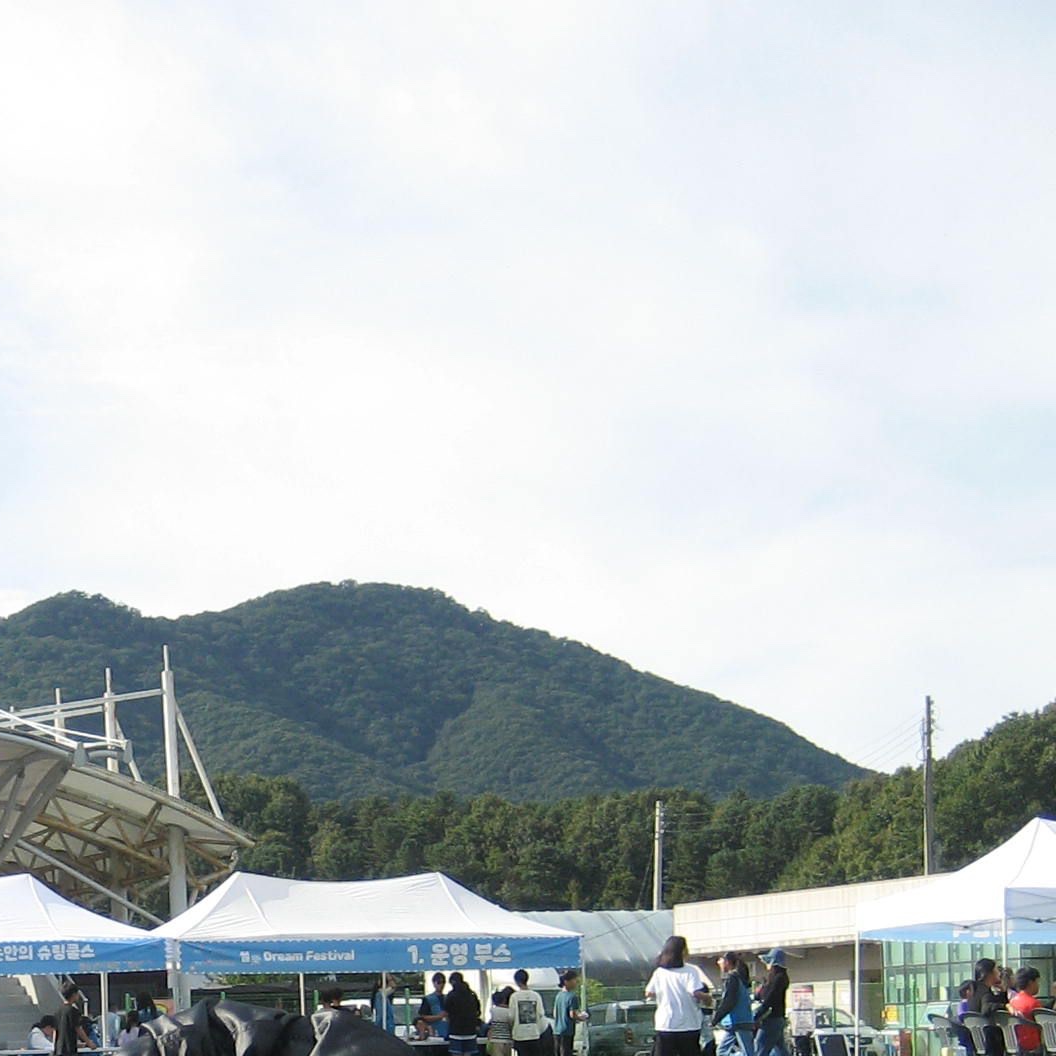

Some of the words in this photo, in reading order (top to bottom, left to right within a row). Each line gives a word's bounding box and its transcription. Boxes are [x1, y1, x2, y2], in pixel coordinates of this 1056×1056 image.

[263, 951, 303, 962] Dream
[305, 950, 355, 962] Festival
[407, 944, 424, 965] 1.
[430, 943, 469, 966] 운영
[474, 943, 512, 966] 부스
